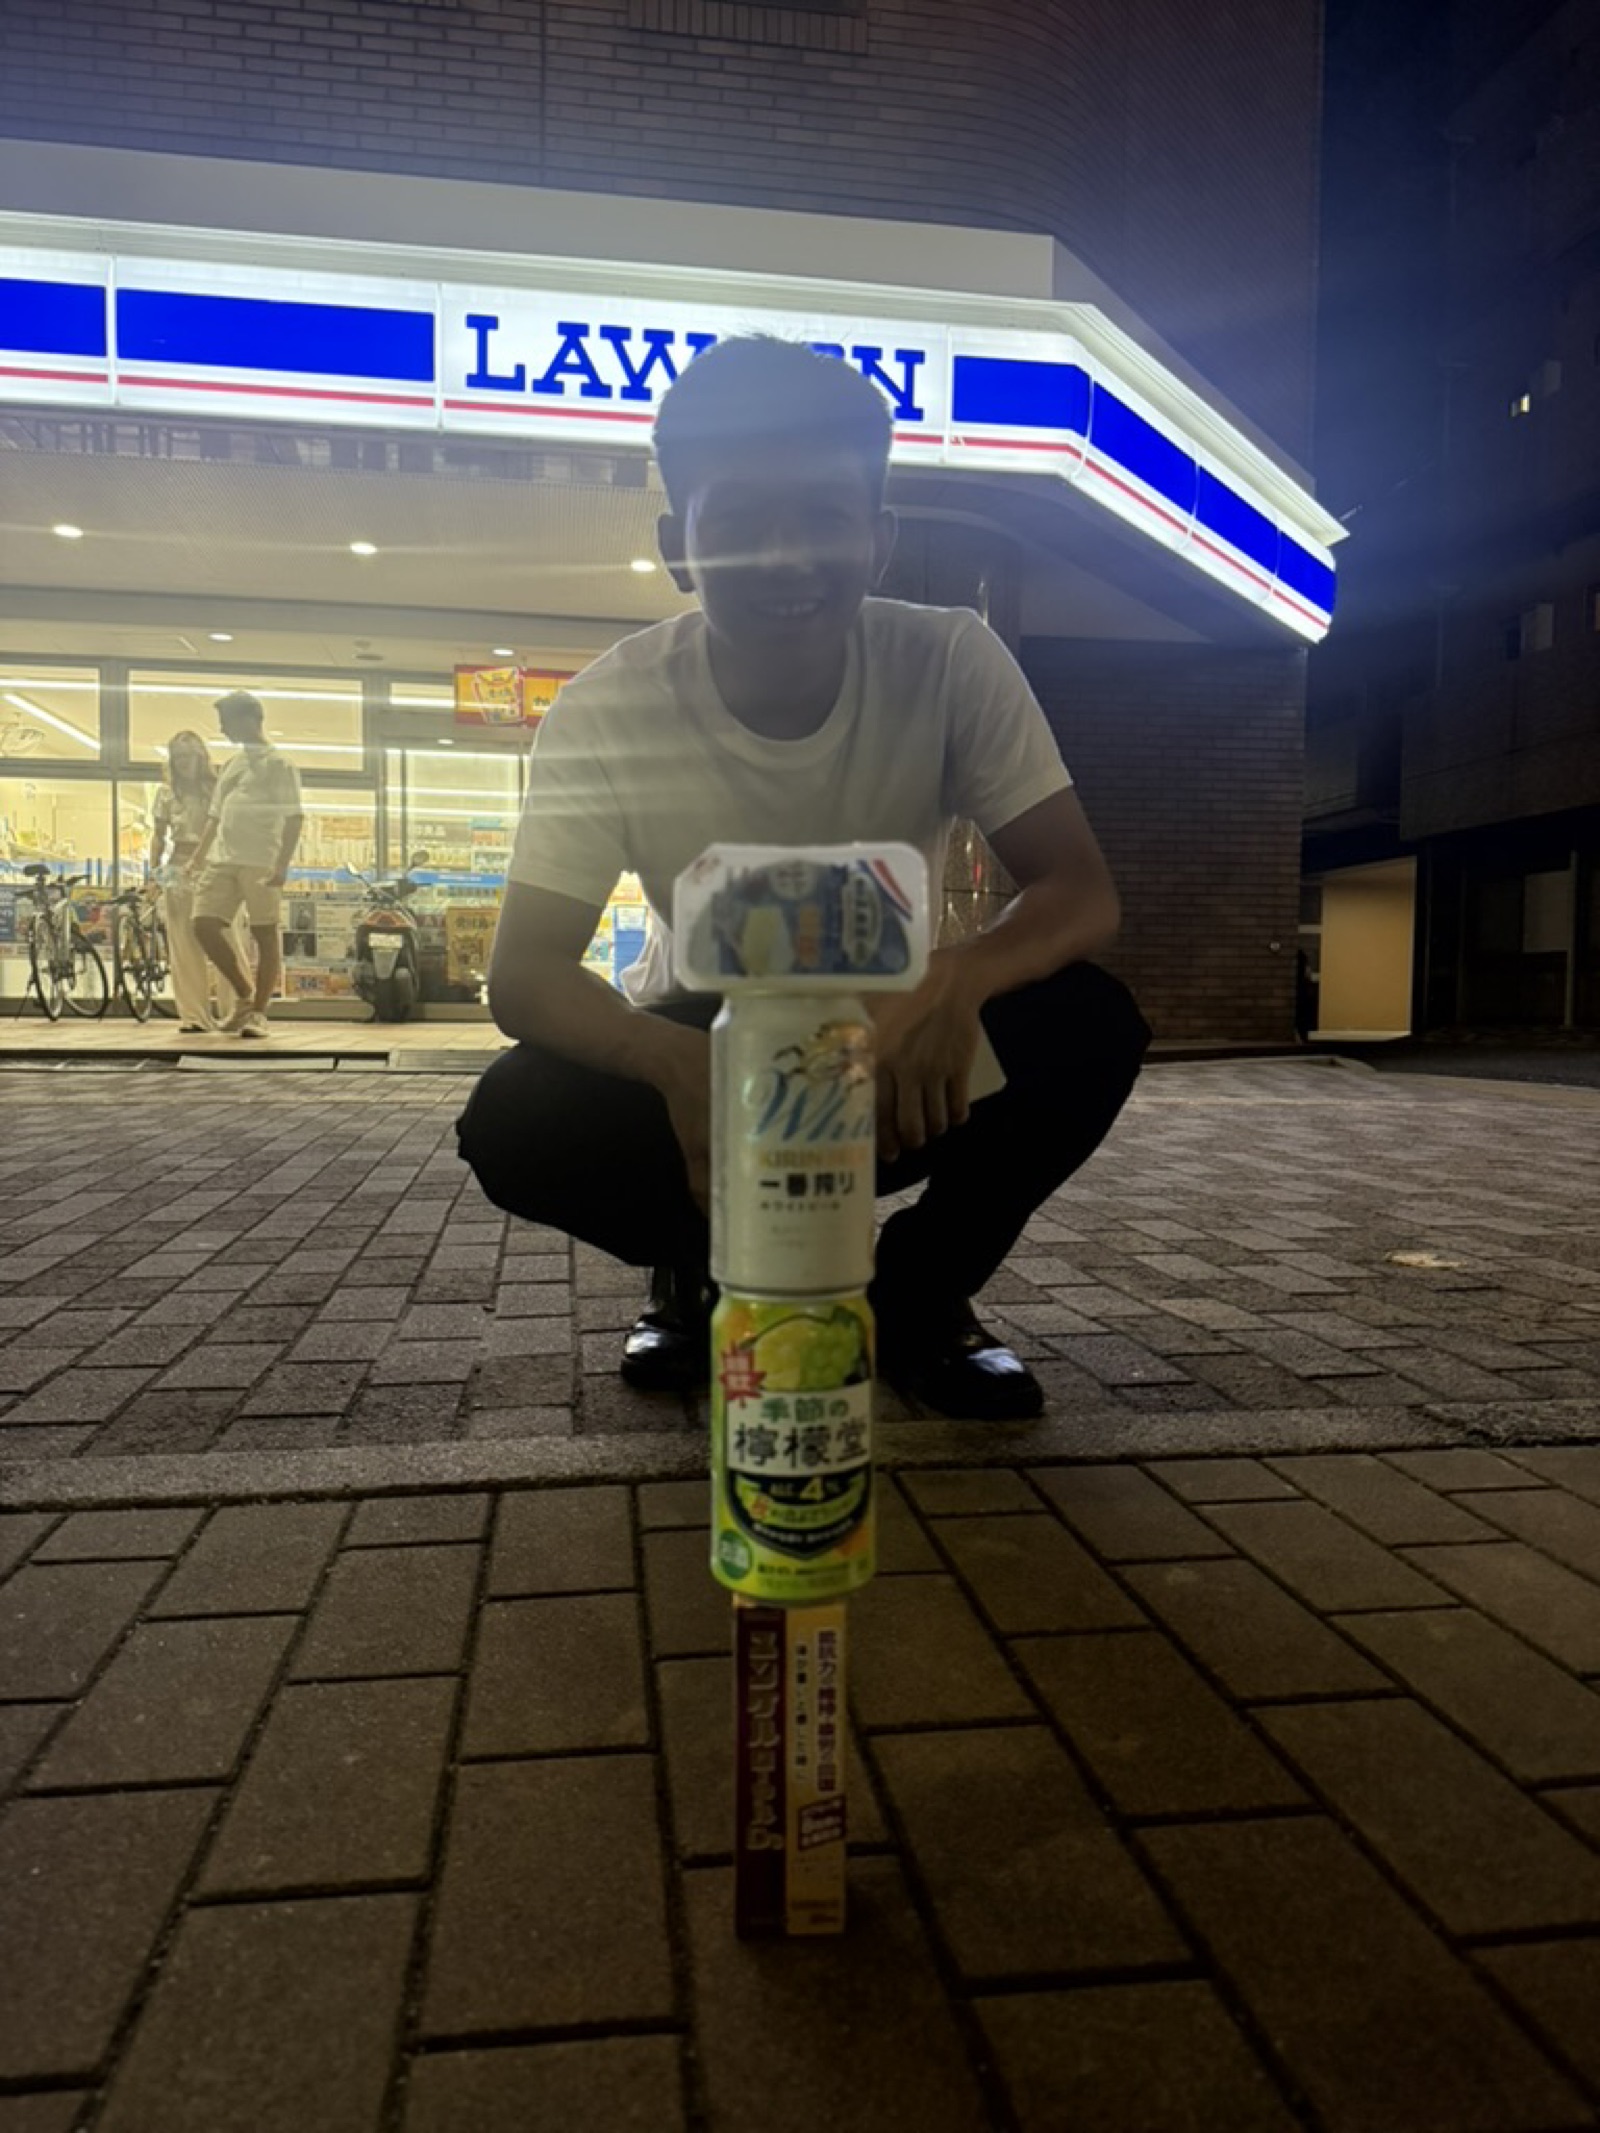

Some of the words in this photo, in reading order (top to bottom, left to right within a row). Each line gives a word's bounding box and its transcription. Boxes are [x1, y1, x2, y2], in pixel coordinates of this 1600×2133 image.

[465, 313, 926, 422] LAWN
[760, 1397, 849, 1423] 季節の
[734, 1418, 868, 1469] 檸檬堂
